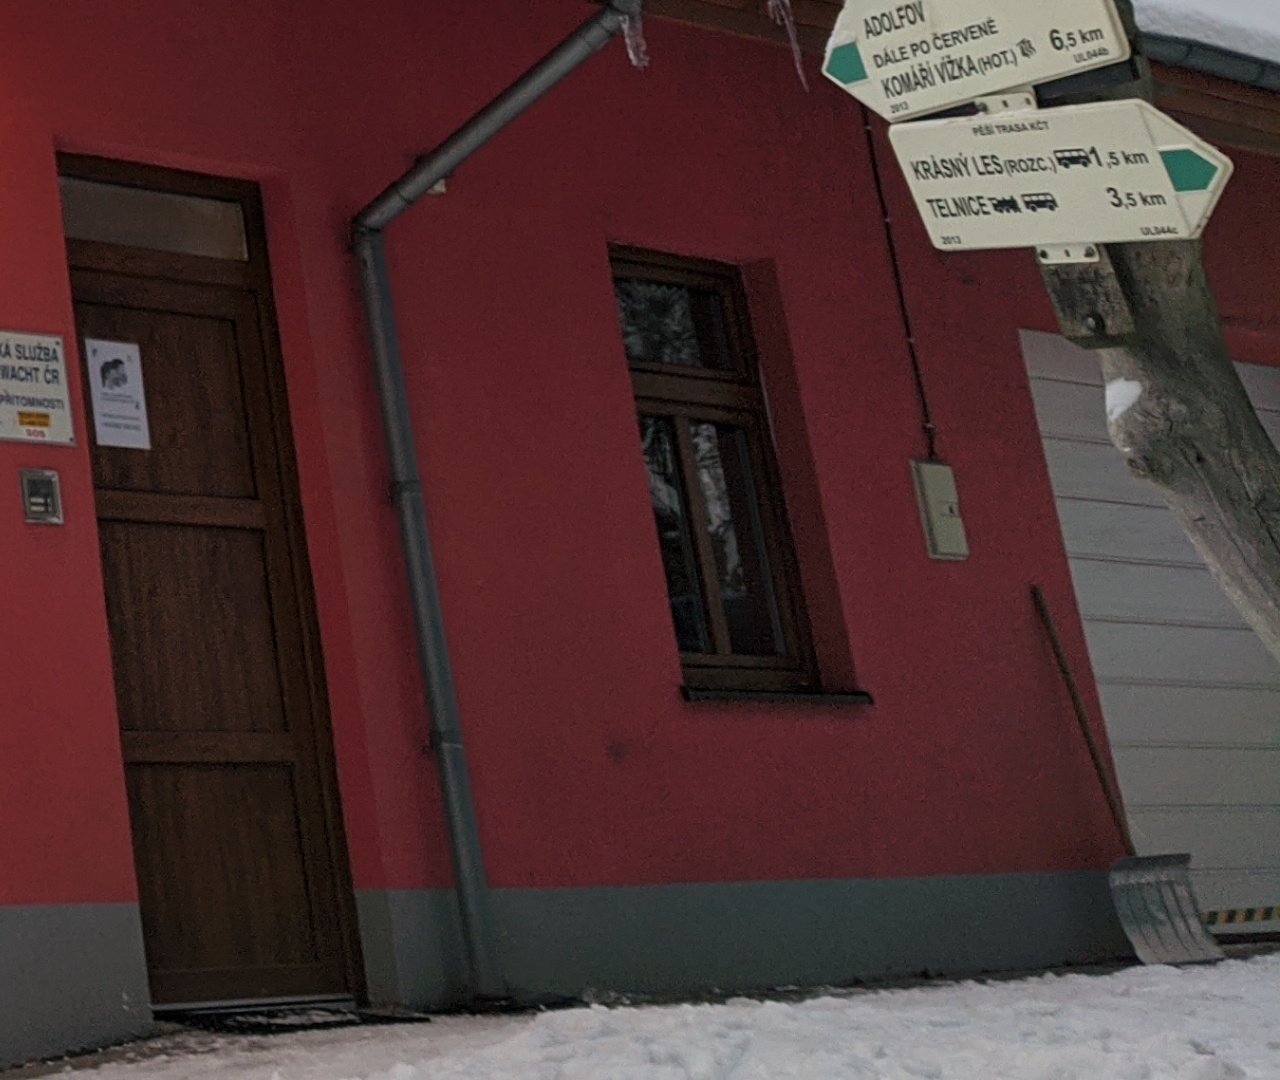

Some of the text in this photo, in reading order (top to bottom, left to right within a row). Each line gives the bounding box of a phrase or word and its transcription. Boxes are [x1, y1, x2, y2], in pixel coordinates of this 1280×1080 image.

[864, 0, 925, 39] ADOLFOV
[872, 16, 999, 68] DÁLE PO ČERVENÉ
[1049, 28, 1104, 51] 6,5 km
[881, 49, 1018, 99] KOMÁŘÍ VÍŽKA (HOT.)
[972, 120, 1050, 136] PĚŠÍ TRASA KČT
[910, 146, 1149, 180] KRÁSNÝ LES (ROZC.) 1,5 km
[926, 187, 1167, 218] TELNICE 3,5 km
[941, 235, 962, 245] 2013
[15, 342, 59, 362] SLUŽBA
[44, 365, 60, 385] ČR
